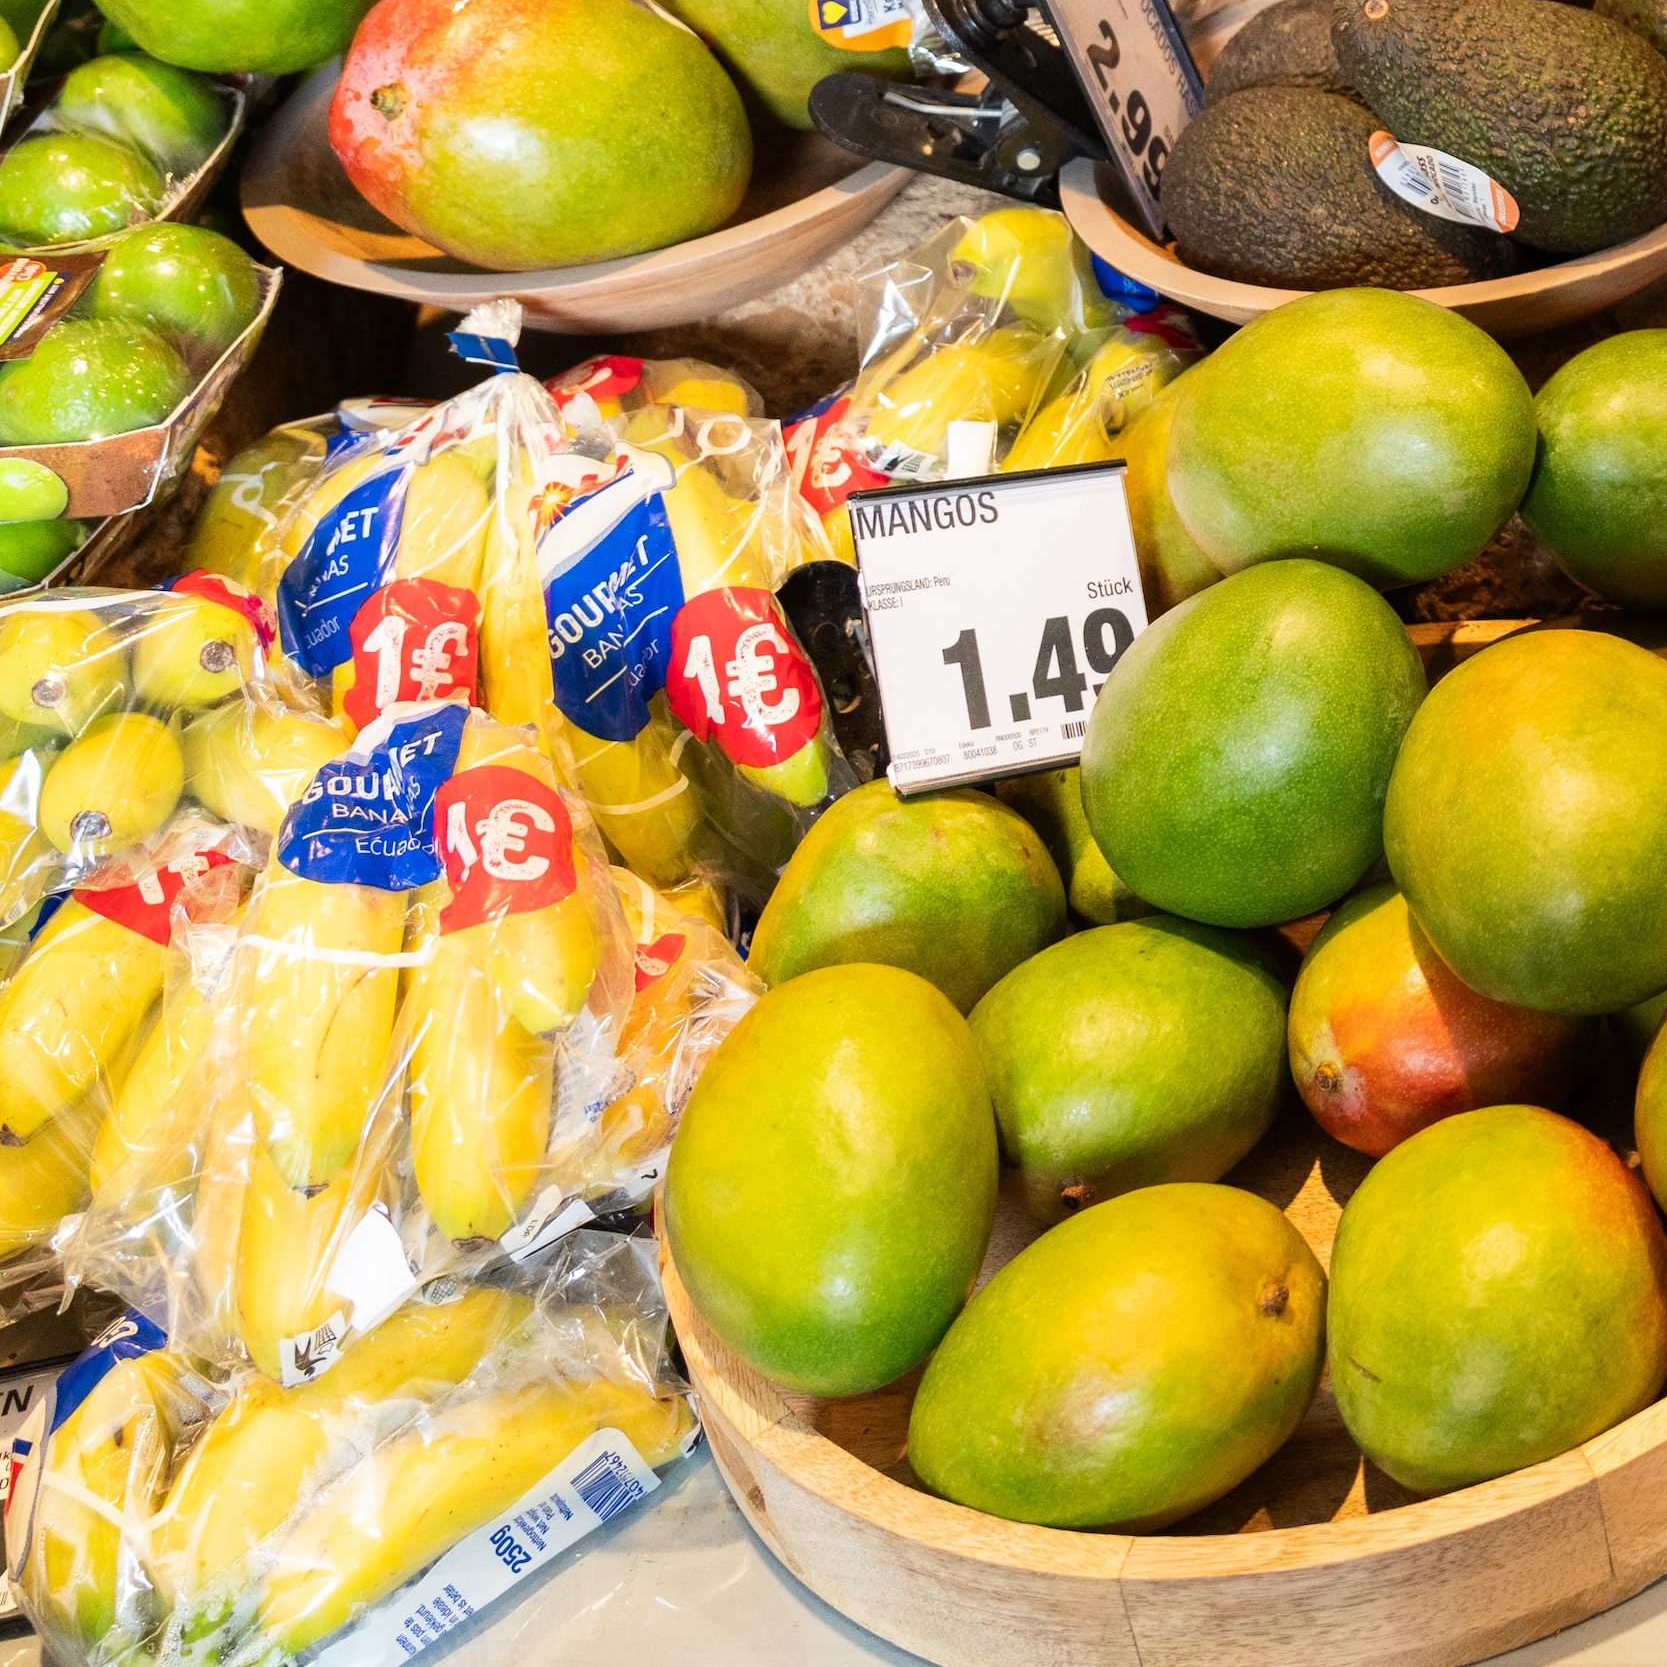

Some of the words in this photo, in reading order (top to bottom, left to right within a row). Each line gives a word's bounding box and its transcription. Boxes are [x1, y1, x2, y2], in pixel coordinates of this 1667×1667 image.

[1086, 18, 1169, 202] 2.99
[855, 492, 999, 540] MANGOS
[866, 577, 934, 598] URSPRUNGSLAND:
[934, 575, 951, 588] Peru
[1086, 577, 1134, 600] Stück
[867, 597, 901, 612] KLASSE:
[362, 615, 470, 710] 1€
[683, 622, 800, 725] 1€
[942, 607, 1136, 731] 1.49
[963, 745, 998, 761] 80041038
[1012, 739, 1024, 751] OG
[1027, 737, 1038, 748] ST
[446, 798, 556, 883] 1€
[488, 1524, 533, 1576] 250g
[442, 1583, 463, 1605] beter
[414, 1603, 446, 1634] gekleurd.
[432, 1596, 454, 1621] ideale
[403, 1616, 415, 1630] te
[410, 1623, 426, 1638] pas
